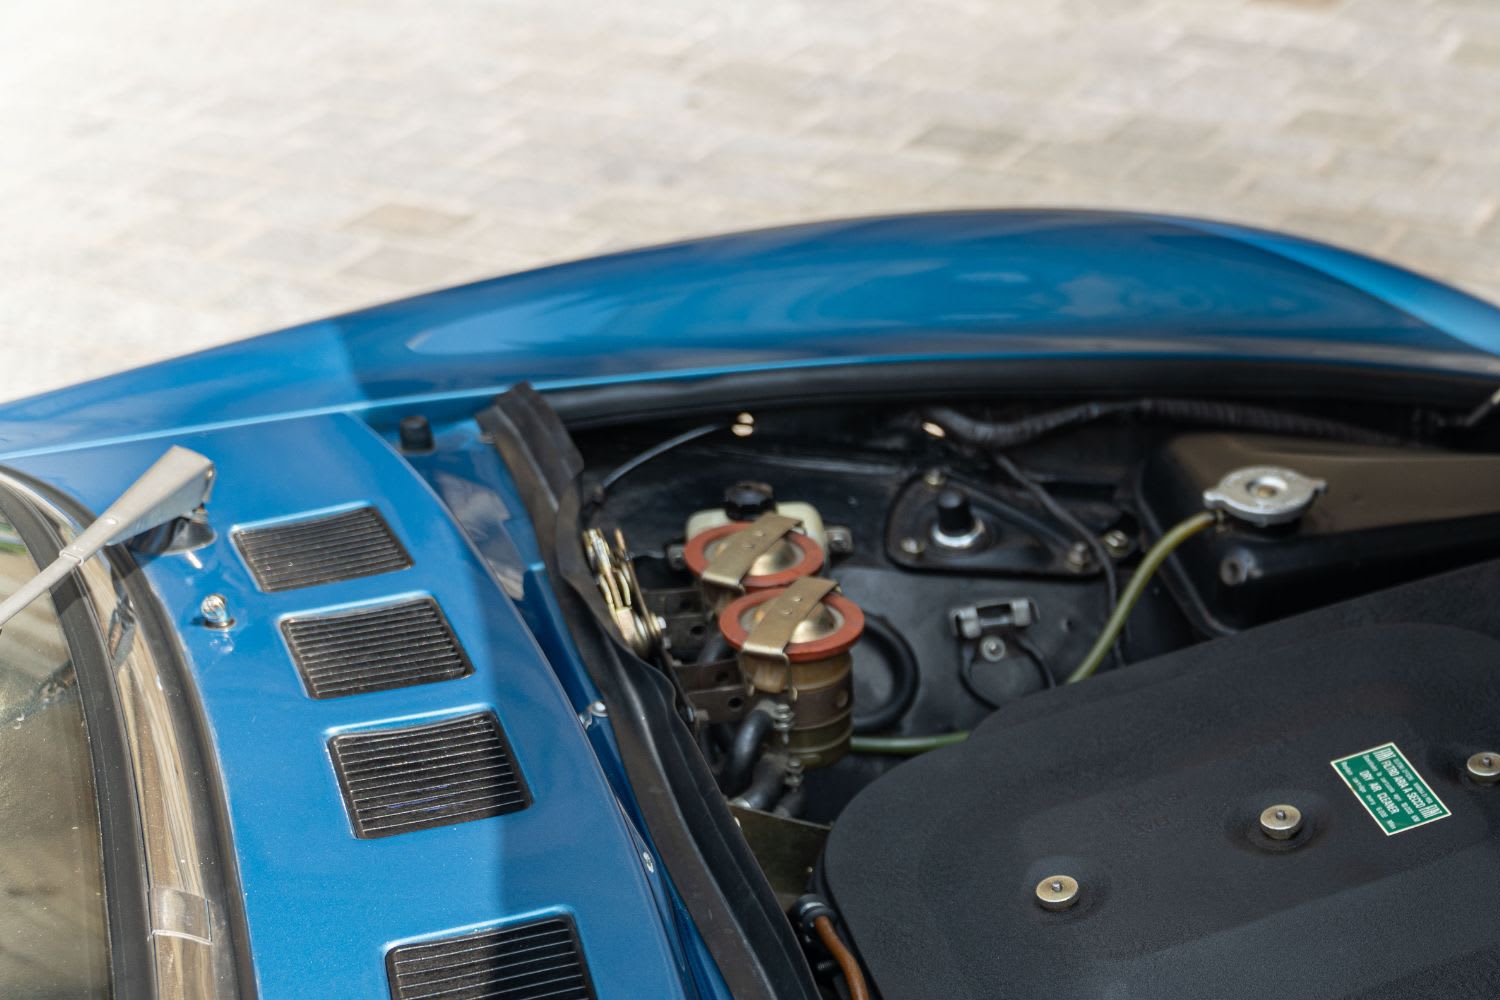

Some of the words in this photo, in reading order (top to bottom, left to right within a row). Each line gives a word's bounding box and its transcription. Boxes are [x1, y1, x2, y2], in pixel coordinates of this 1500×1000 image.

[1359, 770, 1372, 781] DRY
[1370, 782, 1382, 791] AIR
[1377, 792, 1400, 814] CLEANER
[1382, 761, 1400, 776] FILTRO
[1395, 775, 1409, 788] ARIA
[1407, 792, 1426, 808] SECCO
